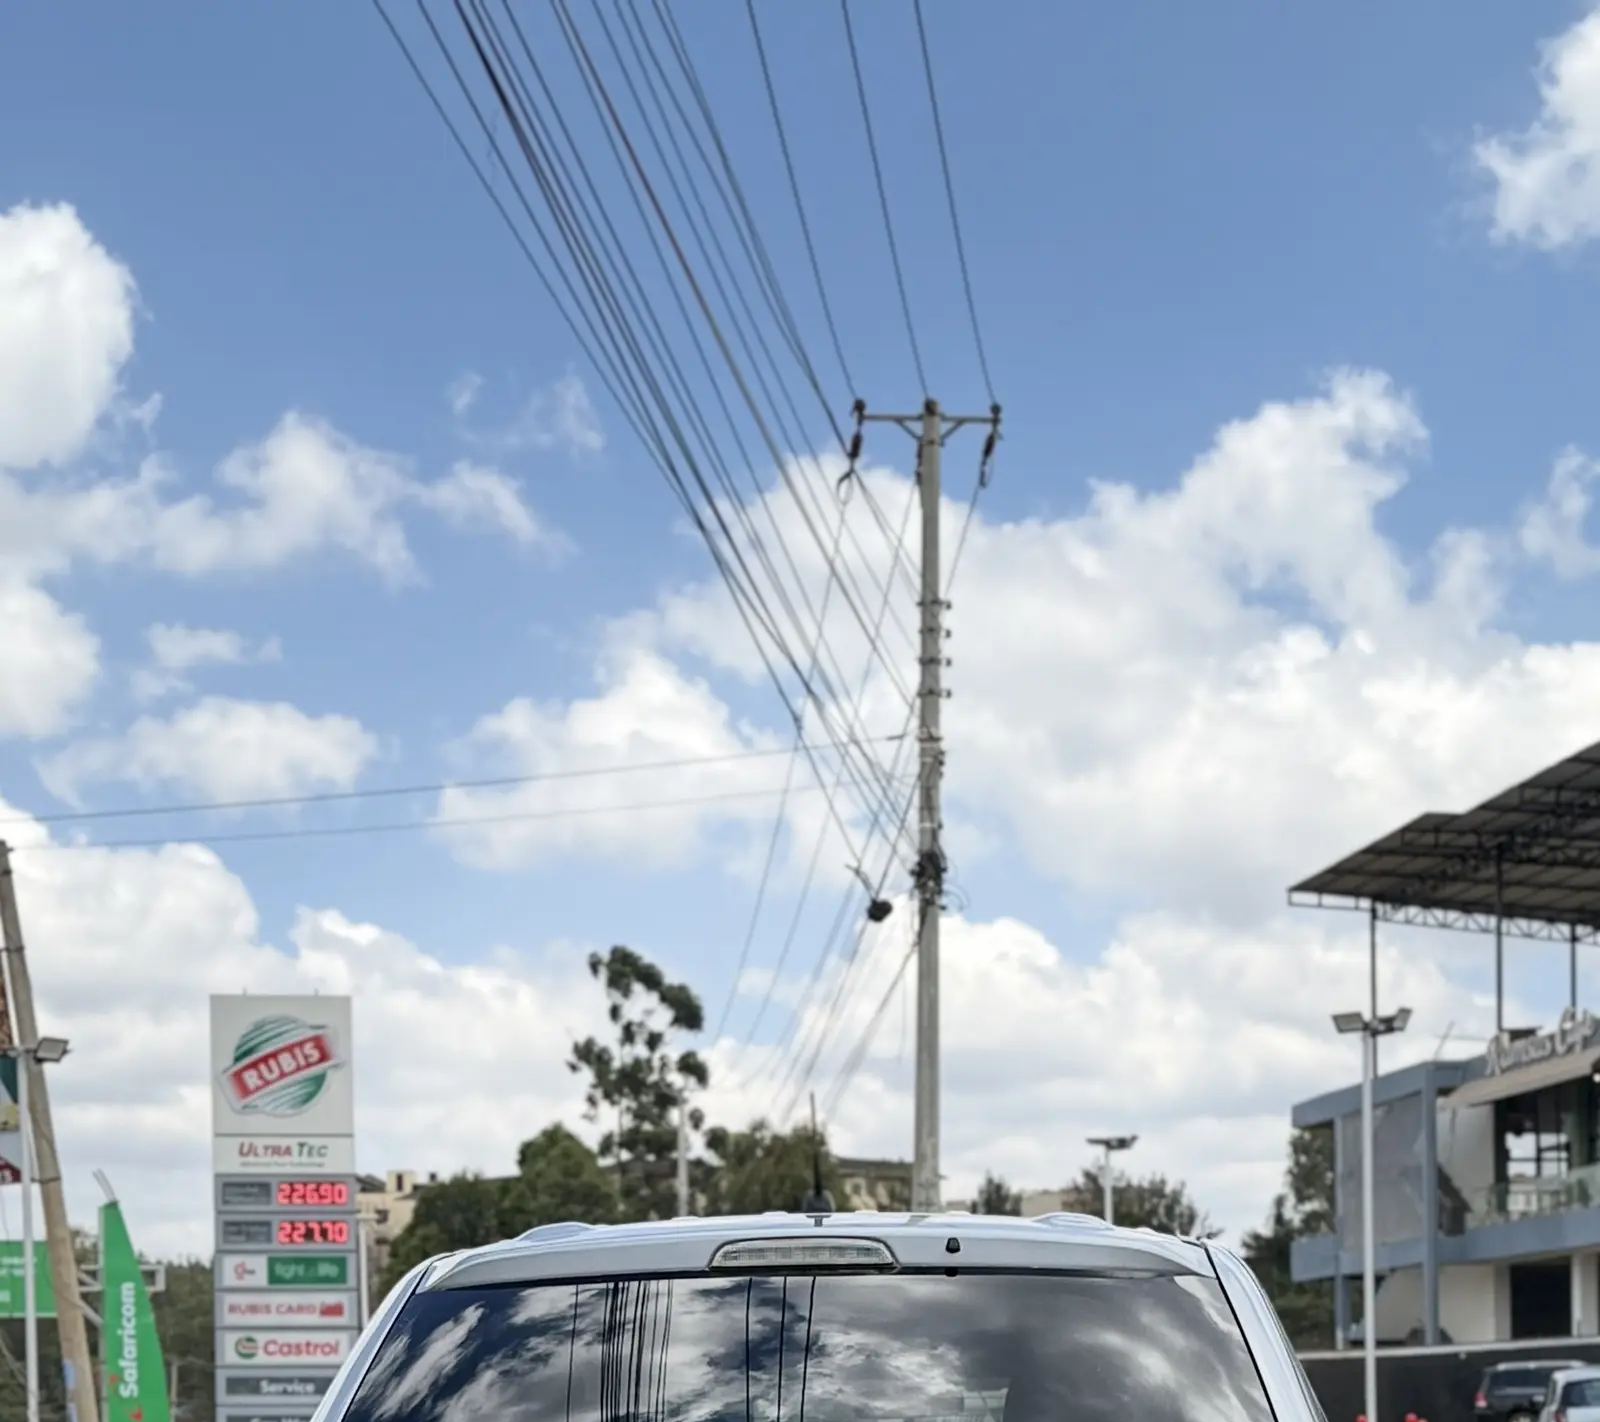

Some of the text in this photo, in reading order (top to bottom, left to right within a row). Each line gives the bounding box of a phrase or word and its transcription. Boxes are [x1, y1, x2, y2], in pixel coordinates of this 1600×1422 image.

[241, 1040, 322, 1092] RUBIS
[117, 1281, 139, 1398] Safaricom
[263, 1339, 340, 1357] Castrol
[260, 1379, 316, 1394] Service
